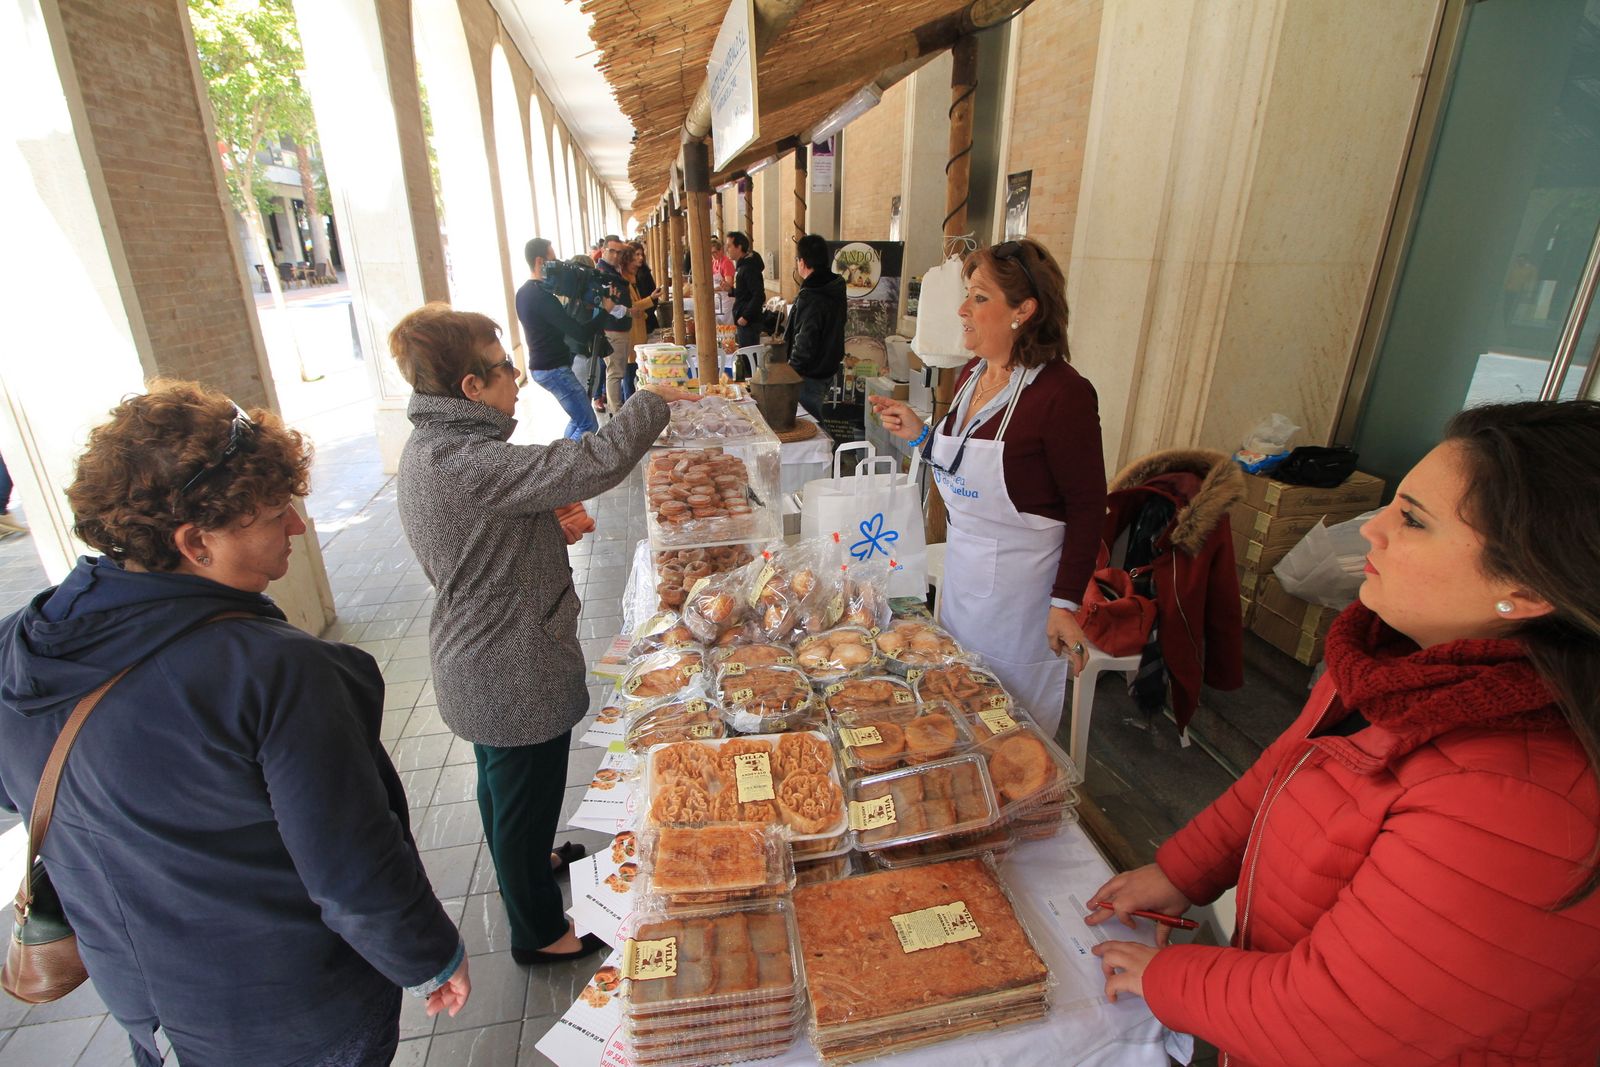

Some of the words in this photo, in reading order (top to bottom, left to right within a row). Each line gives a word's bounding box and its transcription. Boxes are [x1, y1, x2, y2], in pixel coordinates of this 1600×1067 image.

[884, 798, 893, 821] VILLA
[963, 908, 976, 930] VILLA
[665, 942, 673, 973] VILLA
